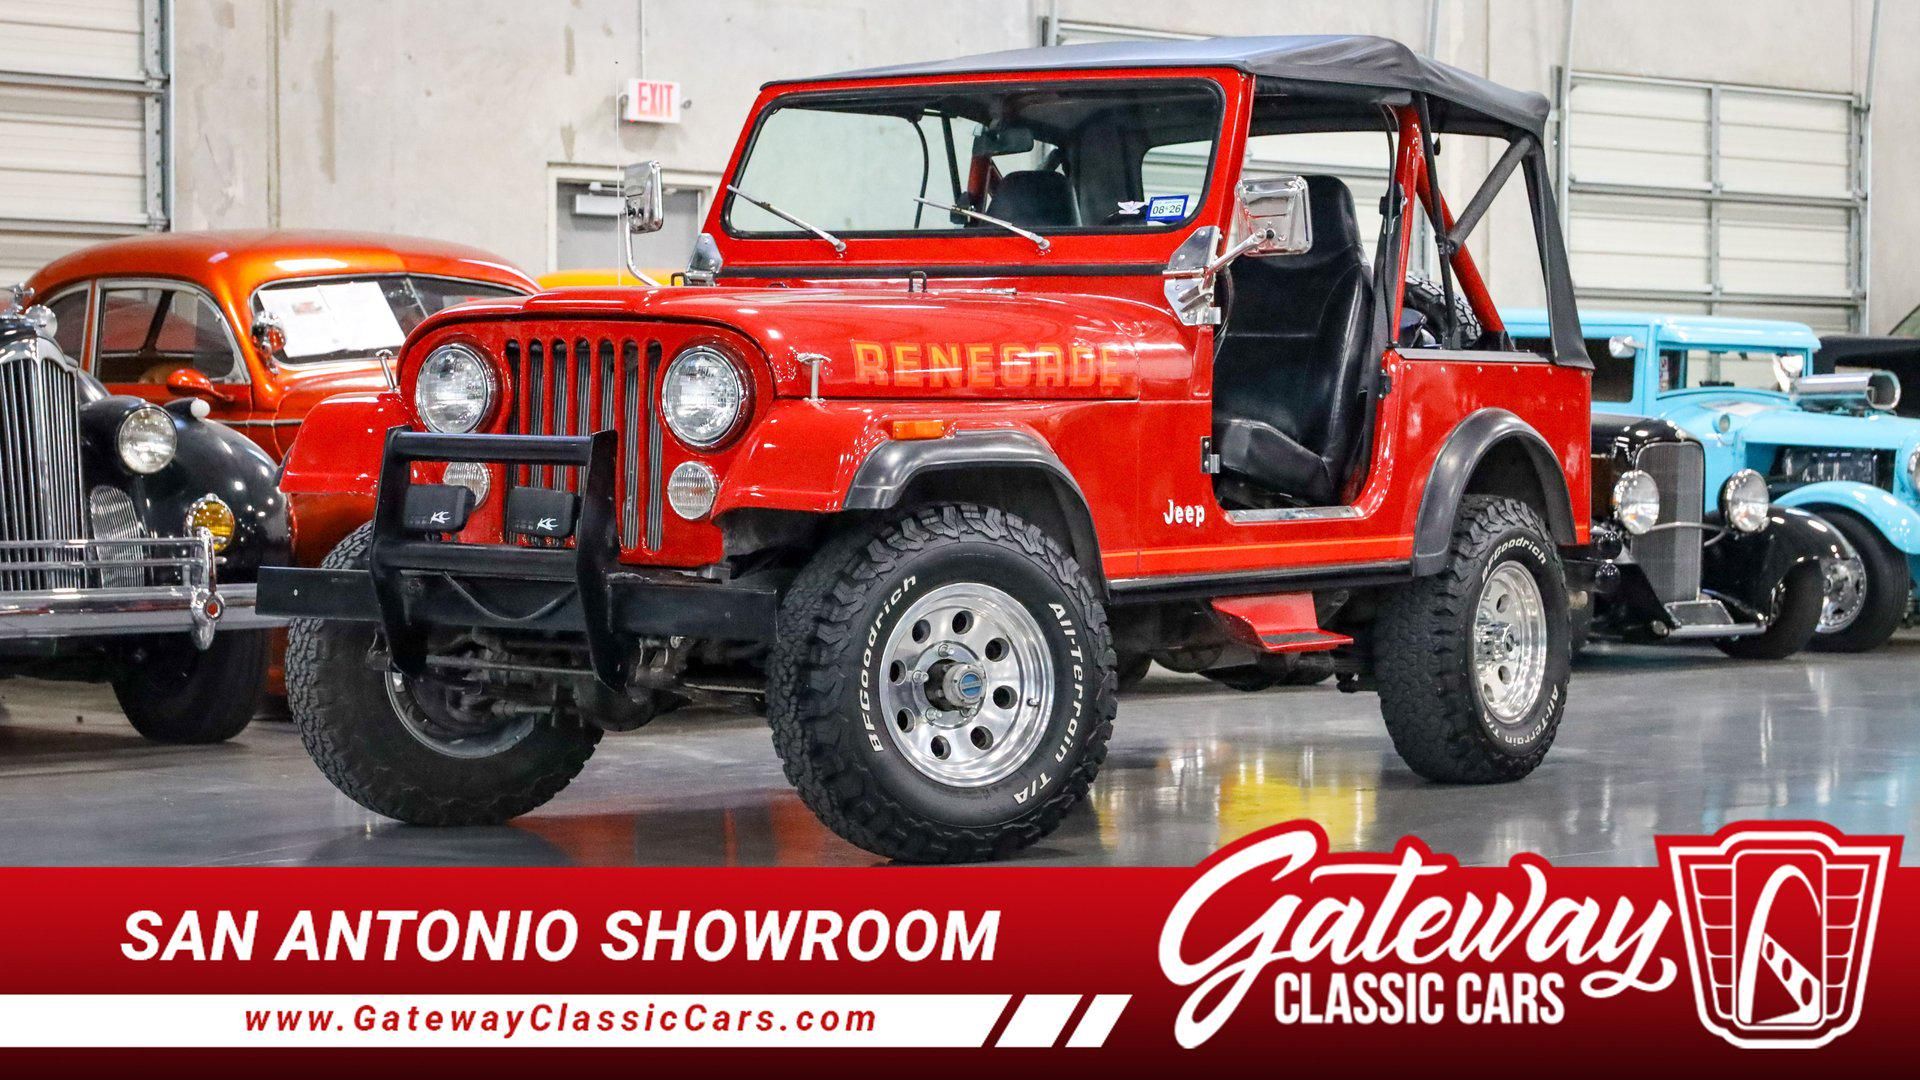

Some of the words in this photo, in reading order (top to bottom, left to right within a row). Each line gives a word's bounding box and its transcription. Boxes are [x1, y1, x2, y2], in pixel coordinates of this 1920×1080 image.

[637, 81, 674, 118] EXIT
[851, 341, 1122, 388] RENEGADE
[430, 511, 451, 524] KC
[537, 518, 559, 531] KC
[1163, 499, 1205, 528] Jeep
[859, 575, 917, 752] BFGoodrich
[1048, 602, 1084, 763] All-Terrain
[1504, 684, 1559, 746] All-Terrain
[1013, 772, 1052, 804] T/A
